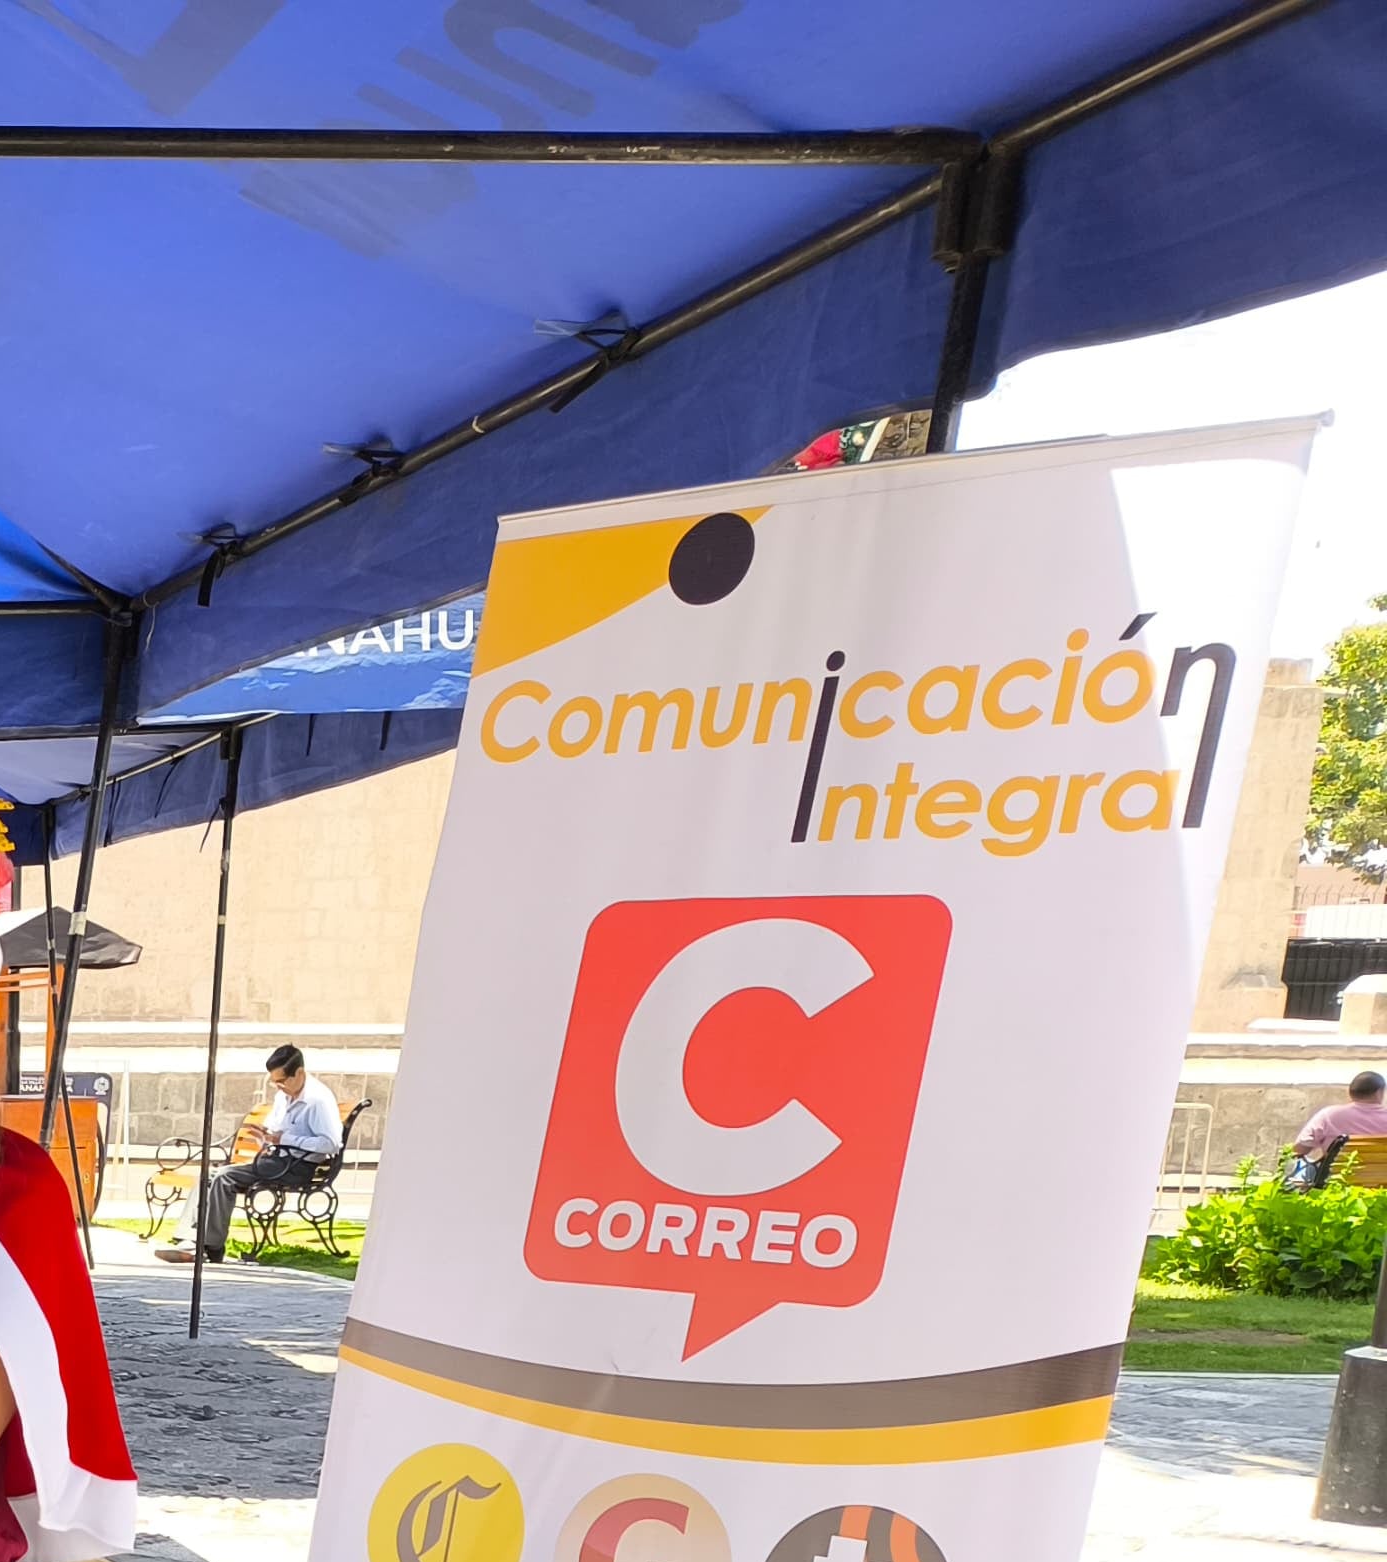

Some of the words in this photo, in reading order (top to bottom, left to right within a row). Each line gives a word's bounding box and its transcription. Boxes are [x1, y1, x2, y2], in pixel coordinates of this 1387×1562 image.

[480, 612, 1237, 810] Comunicación
[615, 917, 875, 1197] C
[553, 1196, 859, 1268] CORREO
